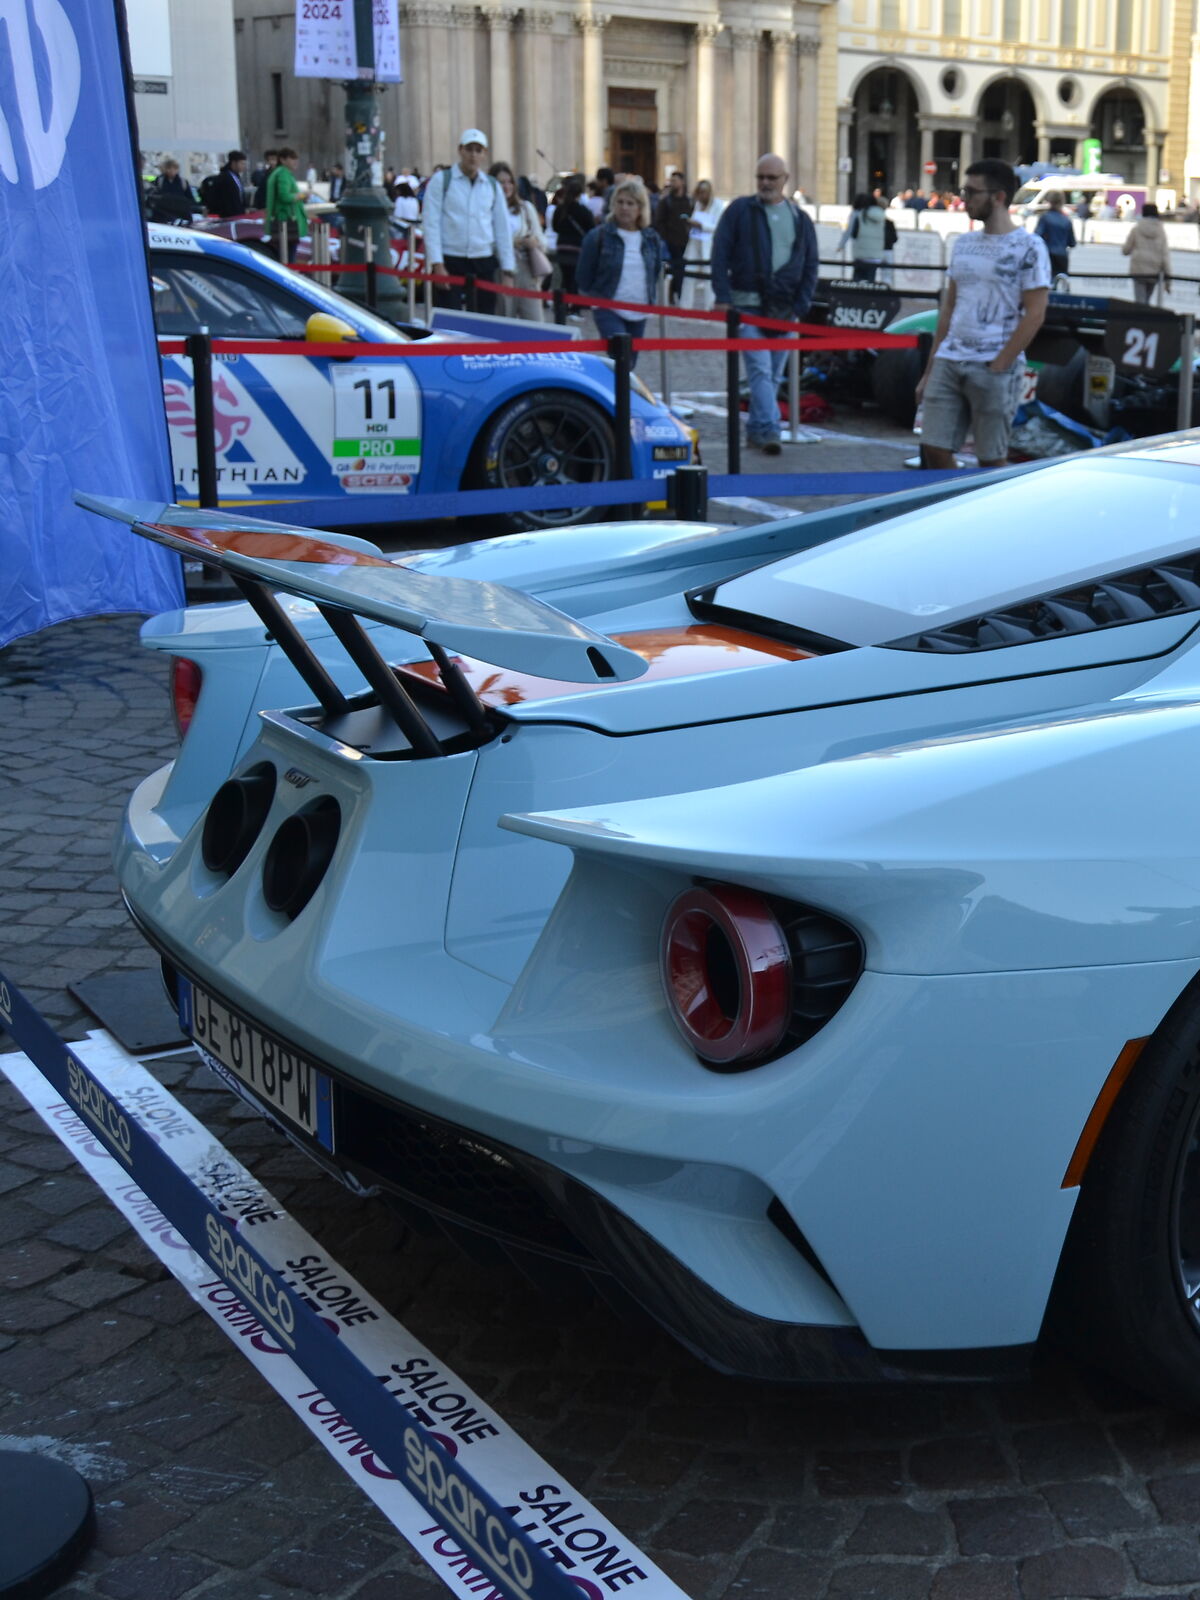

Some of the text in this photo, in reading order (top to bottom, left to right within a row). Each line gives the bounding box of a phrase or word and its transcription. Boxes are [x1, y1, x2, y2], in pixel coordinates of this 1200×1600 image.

[303, 4, 342, 19] 2024
[151, 235, 191, 247] GRAY
[833, 307, 887, 329] SISLEY
[1121, 327, 1159, 370] 21
[353, 379, 396, 420] 11
[179, 468, 299, 482] INTHIAN
[359, 440, 395, 456] PRO
[67, 1055, 132, 1153] sparco
[124, 1086, 195, 1140] SALONE
[203, 1161, 278, 1226] SALONE
[205, 1212, 295, 1334] sparco
[285, 1255, 380, 1328] SALONE
[391, 1358, 500, 1445] SALONE
[403, 1426, 534, 1591] sparco
[519, 1484, 649, 1593] SALONE
